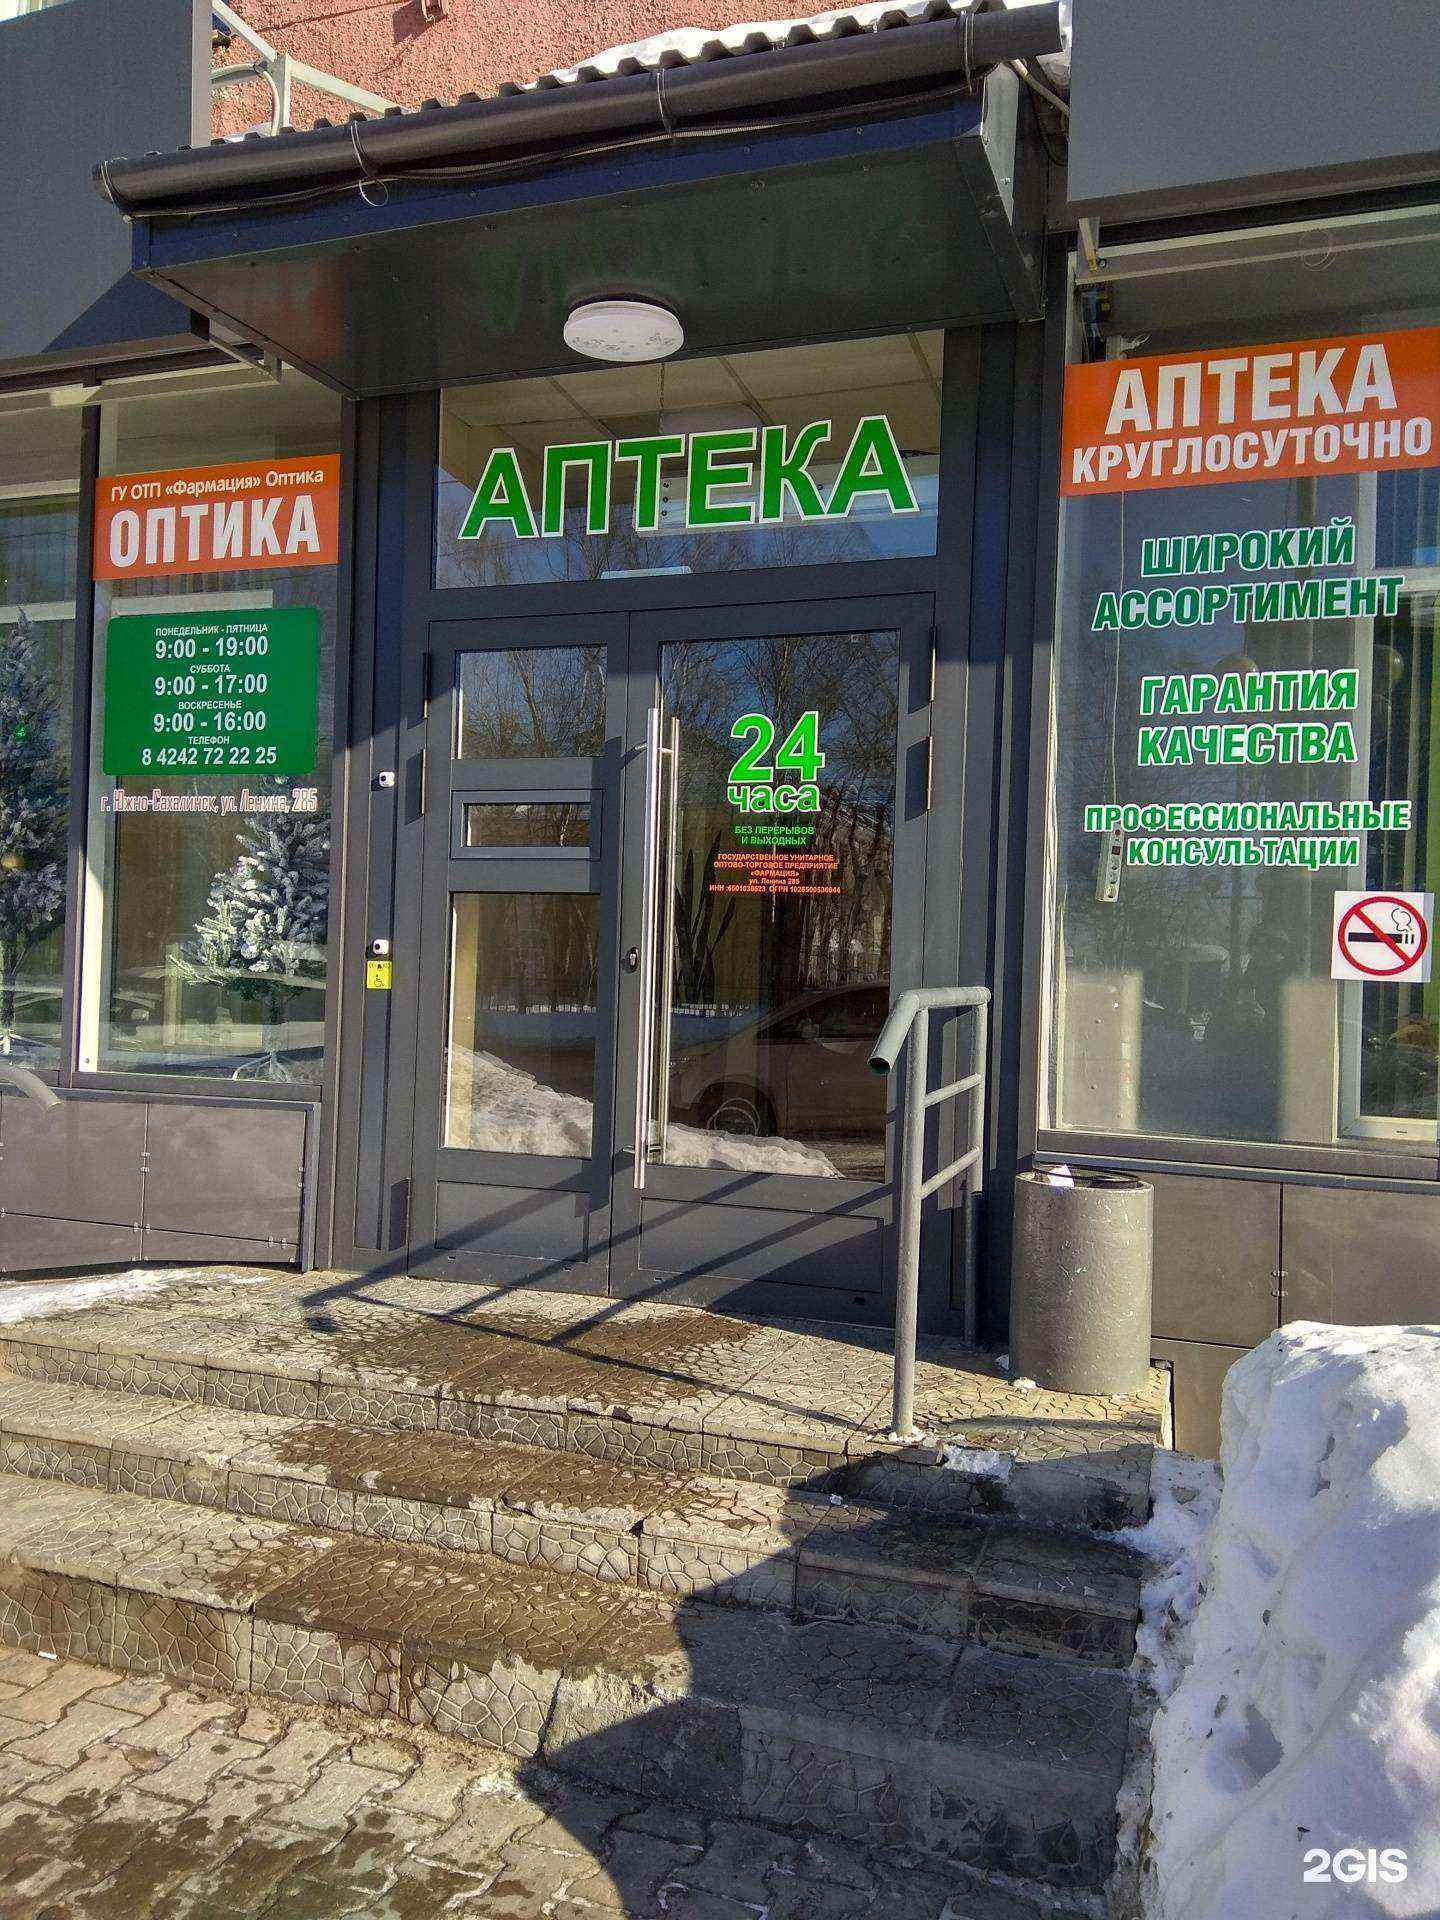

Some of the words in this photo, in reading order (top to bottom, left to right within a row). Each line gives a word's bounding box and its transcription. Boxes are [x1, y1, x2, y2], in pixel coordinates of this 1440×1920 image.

[1104, 343, 1398, 435] АПТЕКА
[1072, 416, 1432, 484] КРУГЛОСУТОЧНО
[111, 485, 127, 501] ГУ
[131, 482, 161, 500] ОТП
[165, 476, 261, 498] «Фармация»
[265, 469, 324, 489] Оптика
[457, 413, 920, 541] АПТЕКА
[110, 495, 321, 568] ОПТИКА
[1140, 516, 1356, 578] ШИРОКИЙ
[1091, 575, 1405, 631] АССОРТИМЕНТ
[155, 626, 219, 636] ПОНЕДЕЛЬНИК
[226, 623, 268, 634] ПЯТНИЦА
[156, 639, 196, 659] 9:00
[215, 636, 268, 656] 19:00
[190, 664, 231, 674] СУББОТА
[155, 676, 196, 696] 9:00
[215, 673, 267, 694] 17:00
[1139, 669, 1360, 716] ГАРАНТИЯ
[178, 699, 242, 710] ВОСКРЕСЕНЬЕ
[153, 713, 194, 732] 9:00
[214, 710, 266, 731] 16:00
[188, 735, 230, 745] ТЕЛЕФОН
[728, 710, 826, 784] 24
[1137, 722, 1358, 767] КАЧЕСТВА
[142, 748, 152, 766] 8
[157, 747, 198, 765] 4242
[203, 747, 224, 765] 72
[229, 747, 250, 765] 22
[255, 746, 277, 764] 25
[100, 796, 110, 812] г.
[113, 788, 219, 814] Южно-Сахалинск,
[221, 796, 237, 816] ул.
[239, 789, 290, 814] Ленина,
[291, 788, 317, 811] 285
[727, 784, 822, 814] часа
[734, 826, 753, 835] БЕЗ
[755, 826, 815, 835] ПЕРЕРЫВОВ
[1084, 800, 1412, 832] ПРОФЕССИОНАЛЬНЫЕ
[742, 836, 748, 844] И
[751, 836, 807, 846] ВЫХОДНЫХ
[1126, 836, 1360, 872] КОНСУЛЬТАЦИИ
[714, 861, 784, 869] ОПТОВО-ТОРГОВОЕ
[784, 862, 838, 870] ПРЕДПРИЯТИЕ
[717, 853, 789, 862] ГОСУДАРСТВЕННОЕ
[790, 854, 834, 862] УНИТАРНОЕ
